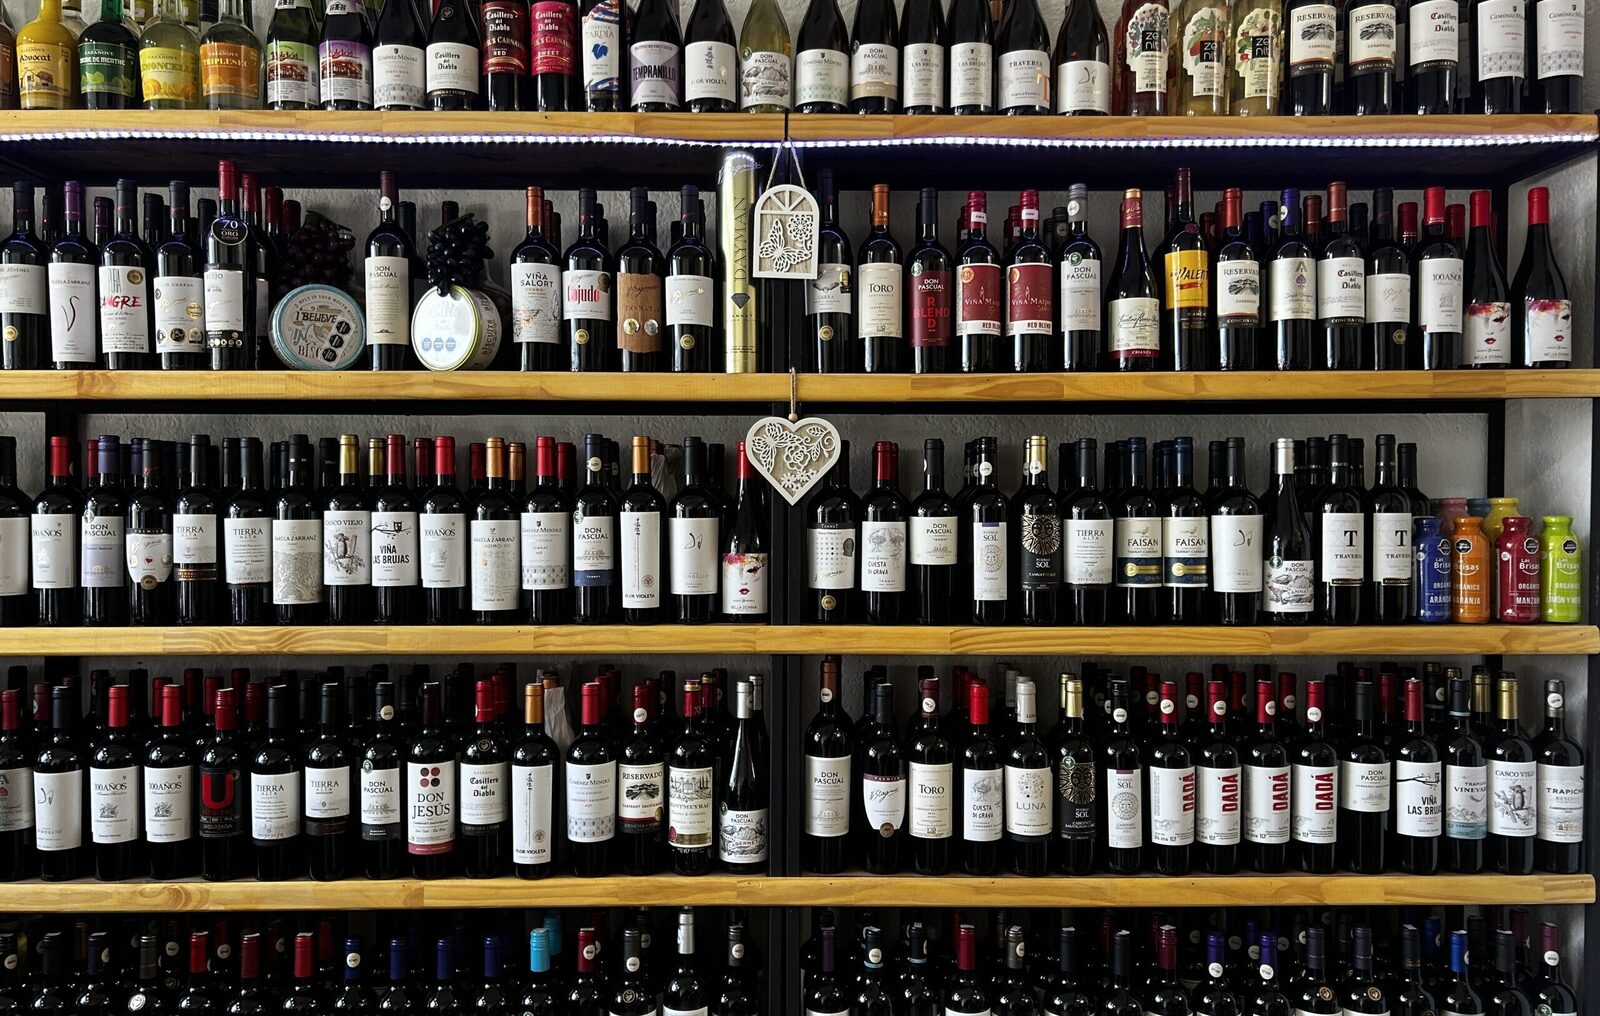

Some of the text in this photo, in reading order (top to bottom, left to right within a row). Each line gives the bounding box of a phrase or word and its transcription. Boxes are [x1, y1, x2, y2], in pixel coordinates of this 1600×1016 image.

[489, 23, 510, 31] Diablo
[538, 23, 559, 31] Diablo
[633, 65, 676, 81] TEMPRANILLO
[222, 220, 238, 229] 70
[734, 197, 747, 282] DAYMAN
[520, 279, 553, 287] SALORT
[1342, 282, 1361, 290] Diablo
[869, 284, 893, 292] TORO
[233, 528, 263, 536] TIERRA
[983, 534, 998, 542] SOL
[1344, 531, 1357, 546] T
[1395, 531, 1407, 546] T
[380, 544, 396, 554] VIÑA
[383, 554, 410, 564] BRUJAS
[623, 771, 662, 779] RESERVADO
[311, 780, 339, 788] TIERRA
[470, 777, 499, 785] Casillero
[202, 774, 235, 809] U
[256, 784, 284, 792] TIERRA
[919, 784, 944, 794] TORO
[473, 789, 495, 797] Diablo
[417, 792, 444, 803] DON
[1422, 797, 1437, 805] VIÑA
[1017, 802, 1047, 810] LUNA
[1408, 806, 1422, 814] LAS
[412, 803, 450, 818] JESÚS
